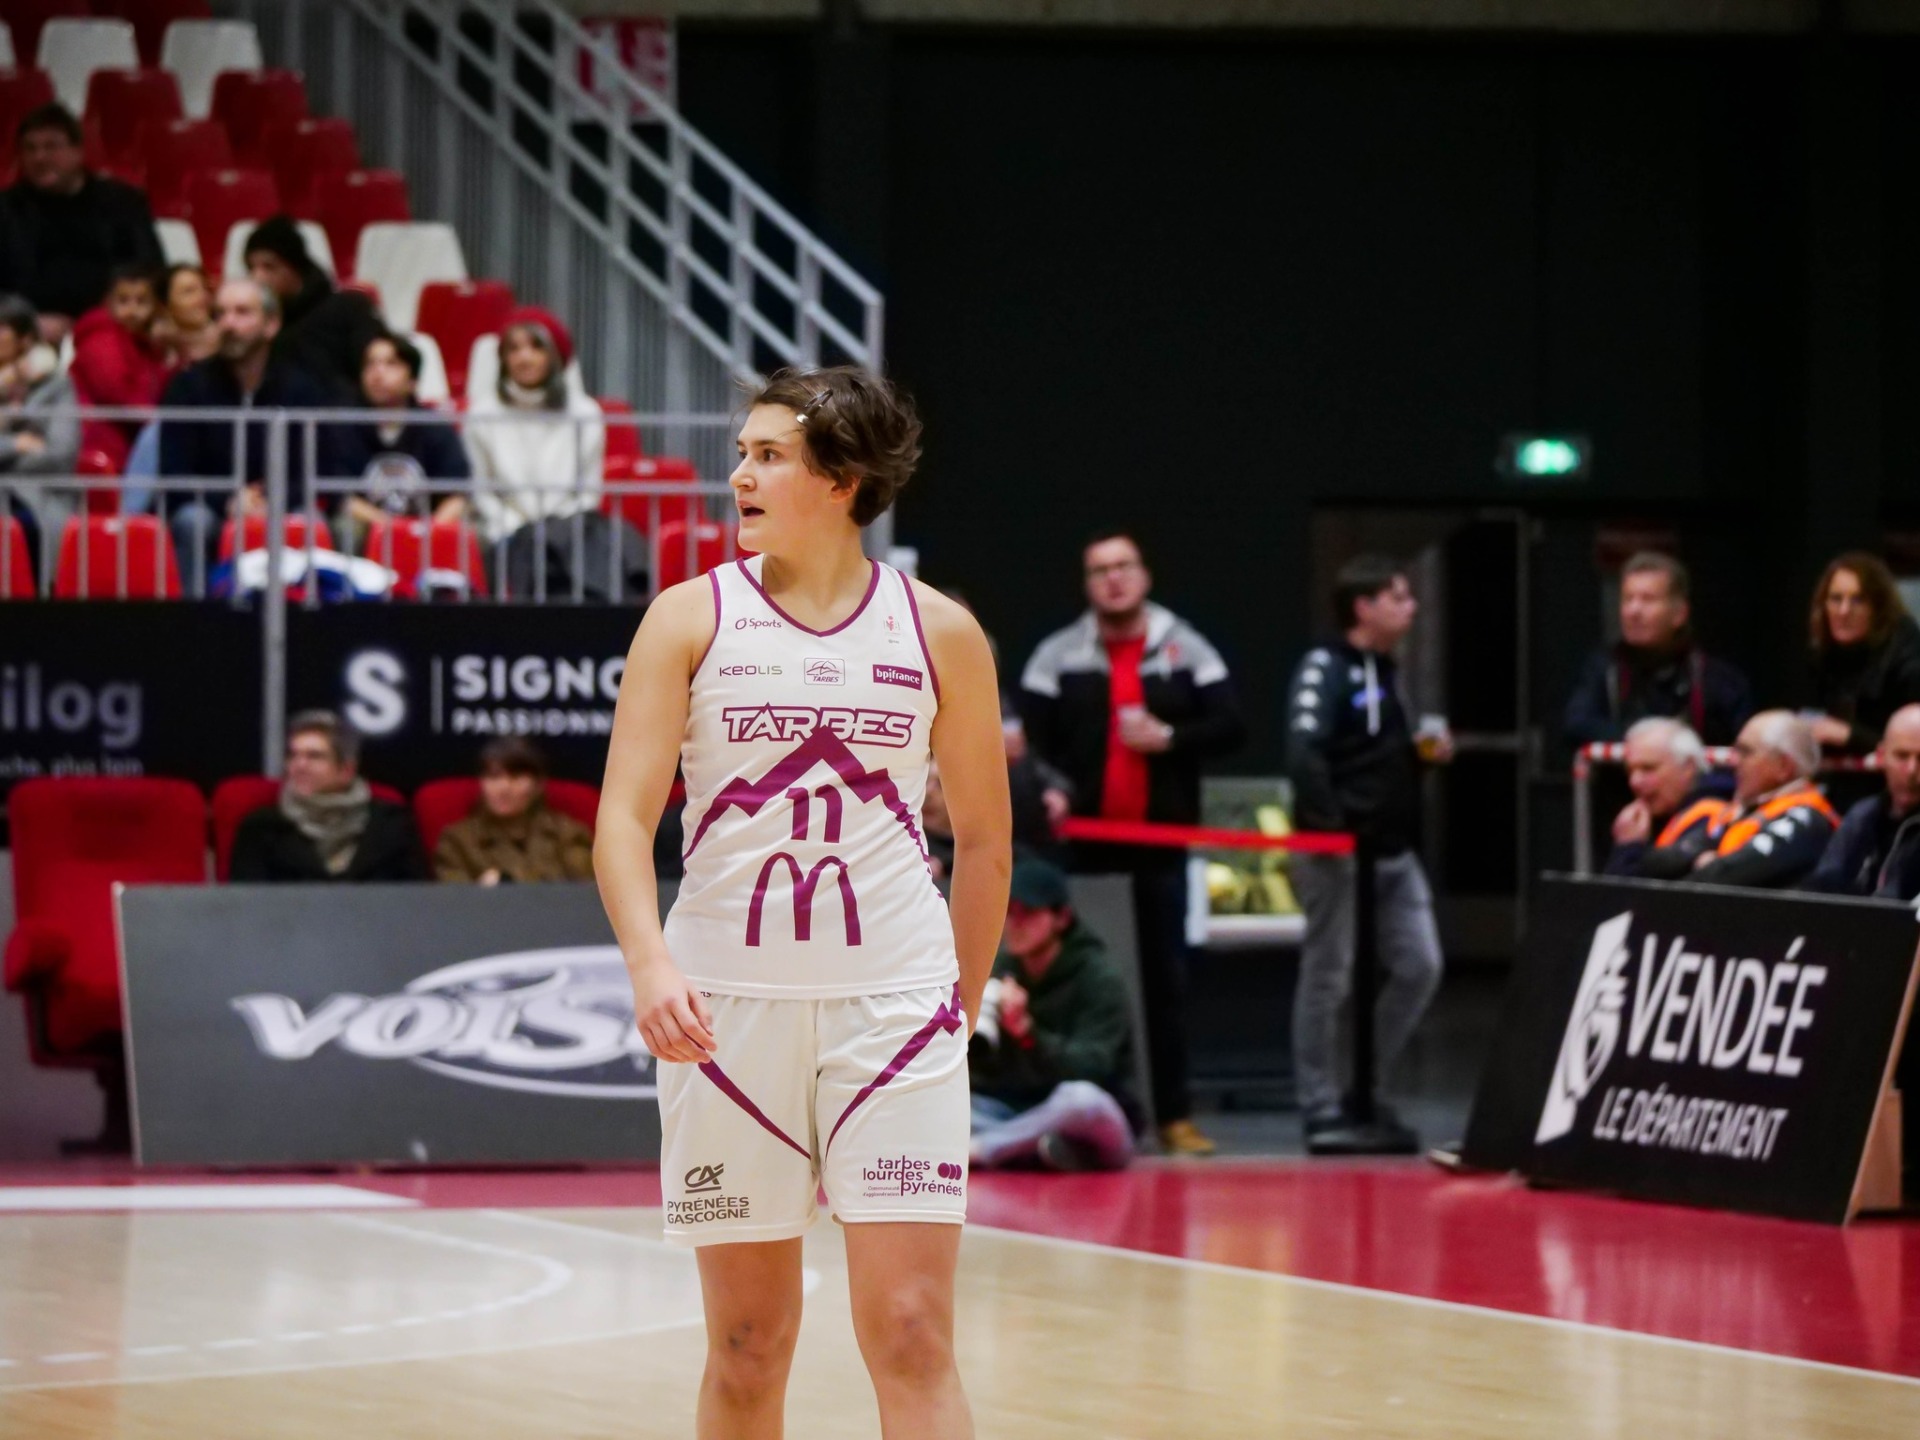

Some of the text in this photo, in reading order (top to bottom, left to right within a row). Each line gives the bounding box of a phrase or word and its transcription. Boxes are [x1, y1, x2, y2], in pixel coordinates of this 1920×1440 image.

[749, 618, 782, 629] Sports
[811, 674, 840, 684] TARBES
[875, 667, 921, 686] bpifrance
[721, 702, 917, 749] TARBES
[784, 783, 843, 844] 11
[1626, 931, 1829, 1078] VENDÉE
[1592, 1081, 1790, 1163] LE DÉPARTEMENT
[877, 1155, 931, 1170] tarbes
[863, 1166, 924, 1181] lourdes
[900, 1179, 963, 1197] pyrénées
[666, 1194, 750, 1213] PYRÉNÉES
[666, 1207, 751, 1225] GASCOGNE
